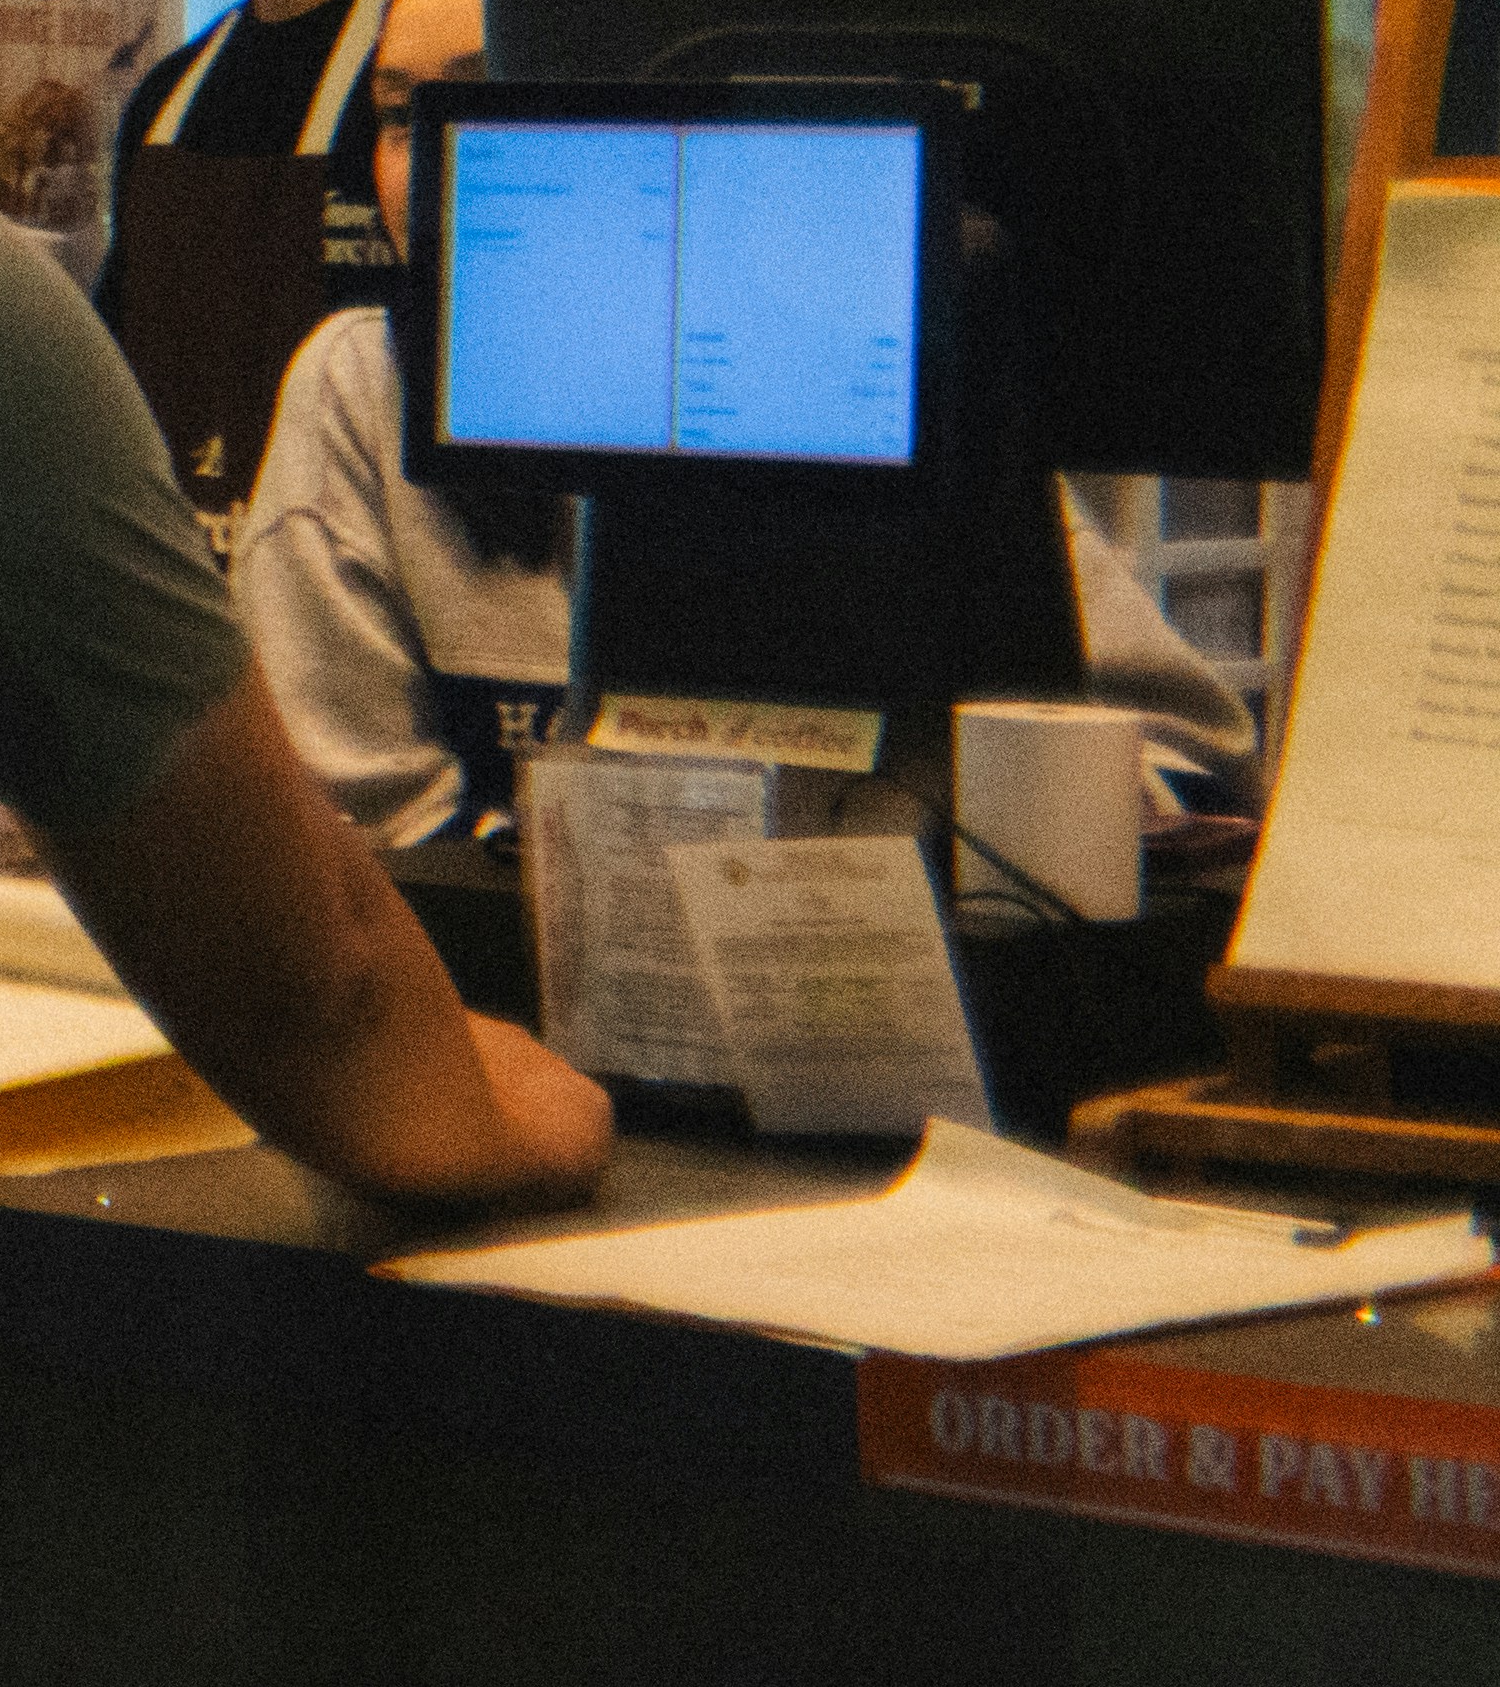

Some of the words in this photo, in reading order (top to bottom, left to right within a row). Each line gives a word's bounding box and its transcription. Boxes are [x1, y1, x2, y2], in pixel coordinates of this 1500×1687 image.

[928, 1390, 1172, 1481] ORDER
[1185, 1422, 1237, 1491] &
[1258, 1435, 1389, 1512] PAY
